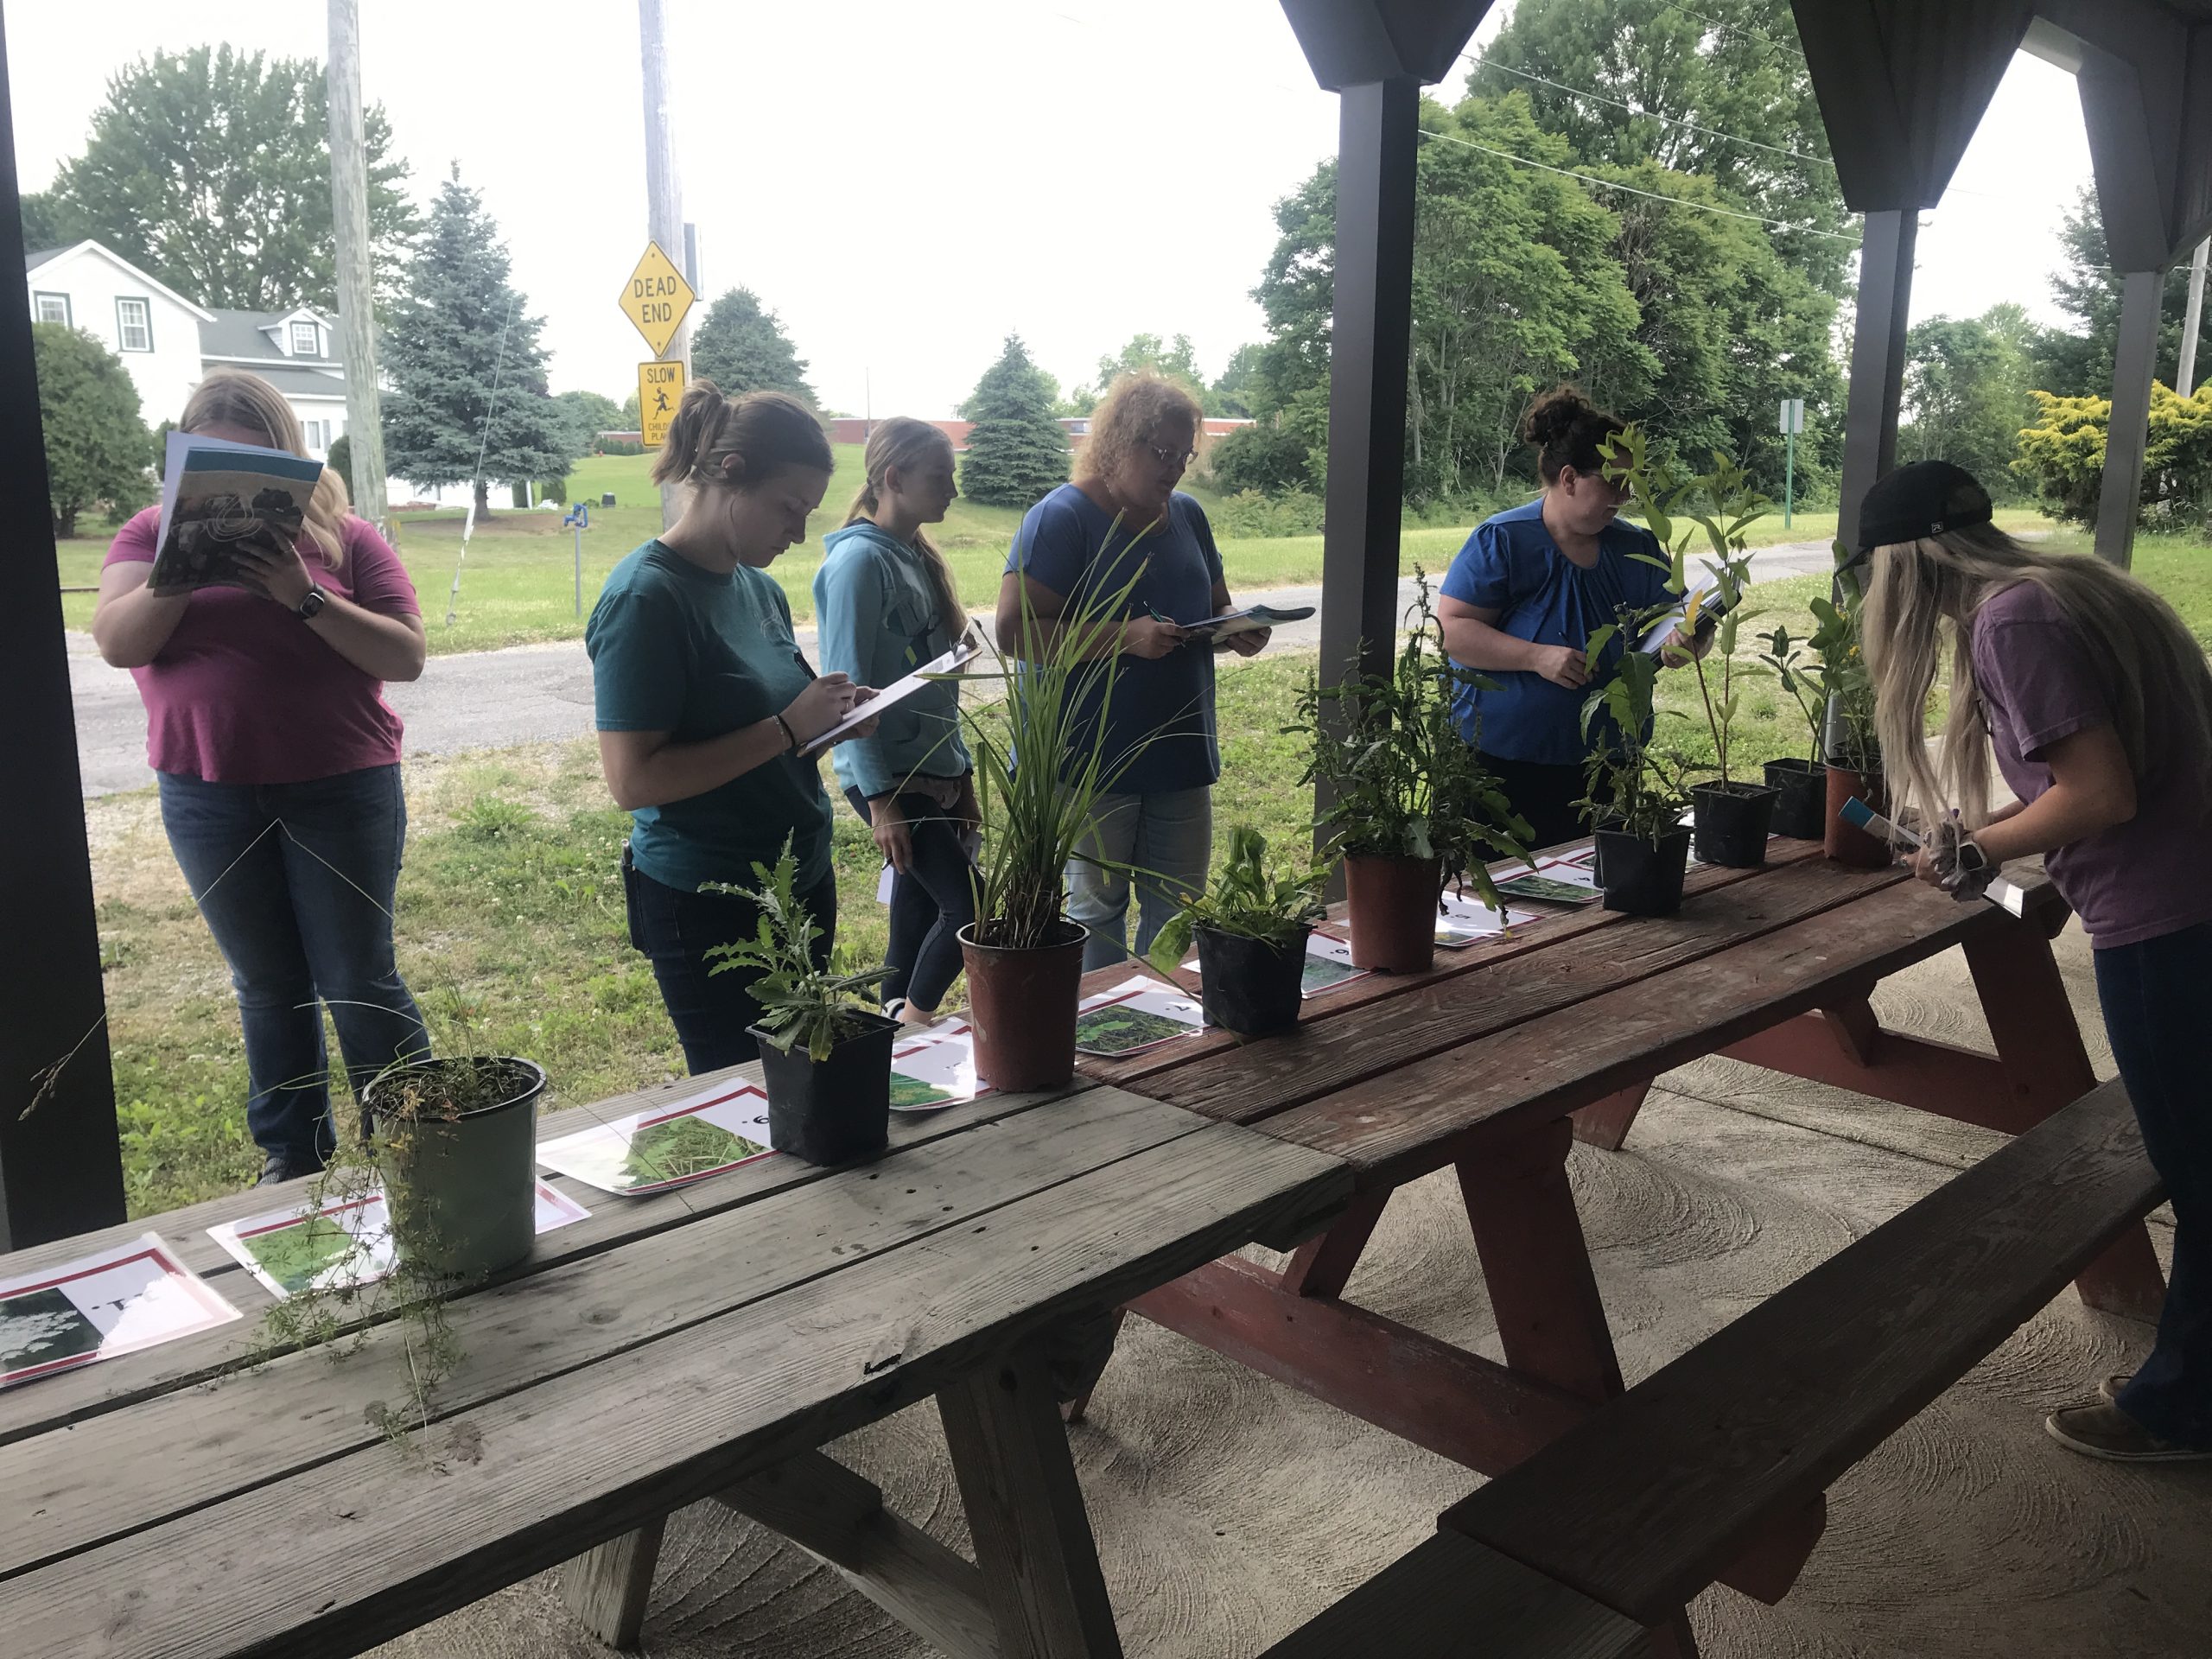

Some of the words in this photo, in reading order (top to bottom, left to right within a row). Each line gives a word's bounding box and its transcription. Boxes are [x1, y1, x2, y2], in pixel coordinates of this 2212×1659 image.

[634, 276, 677, 298] DEAD
[642, 302, 672, 323] END
[646, 367, 676, 384] SLOW
[648, 423, 669, 431] CHILD
